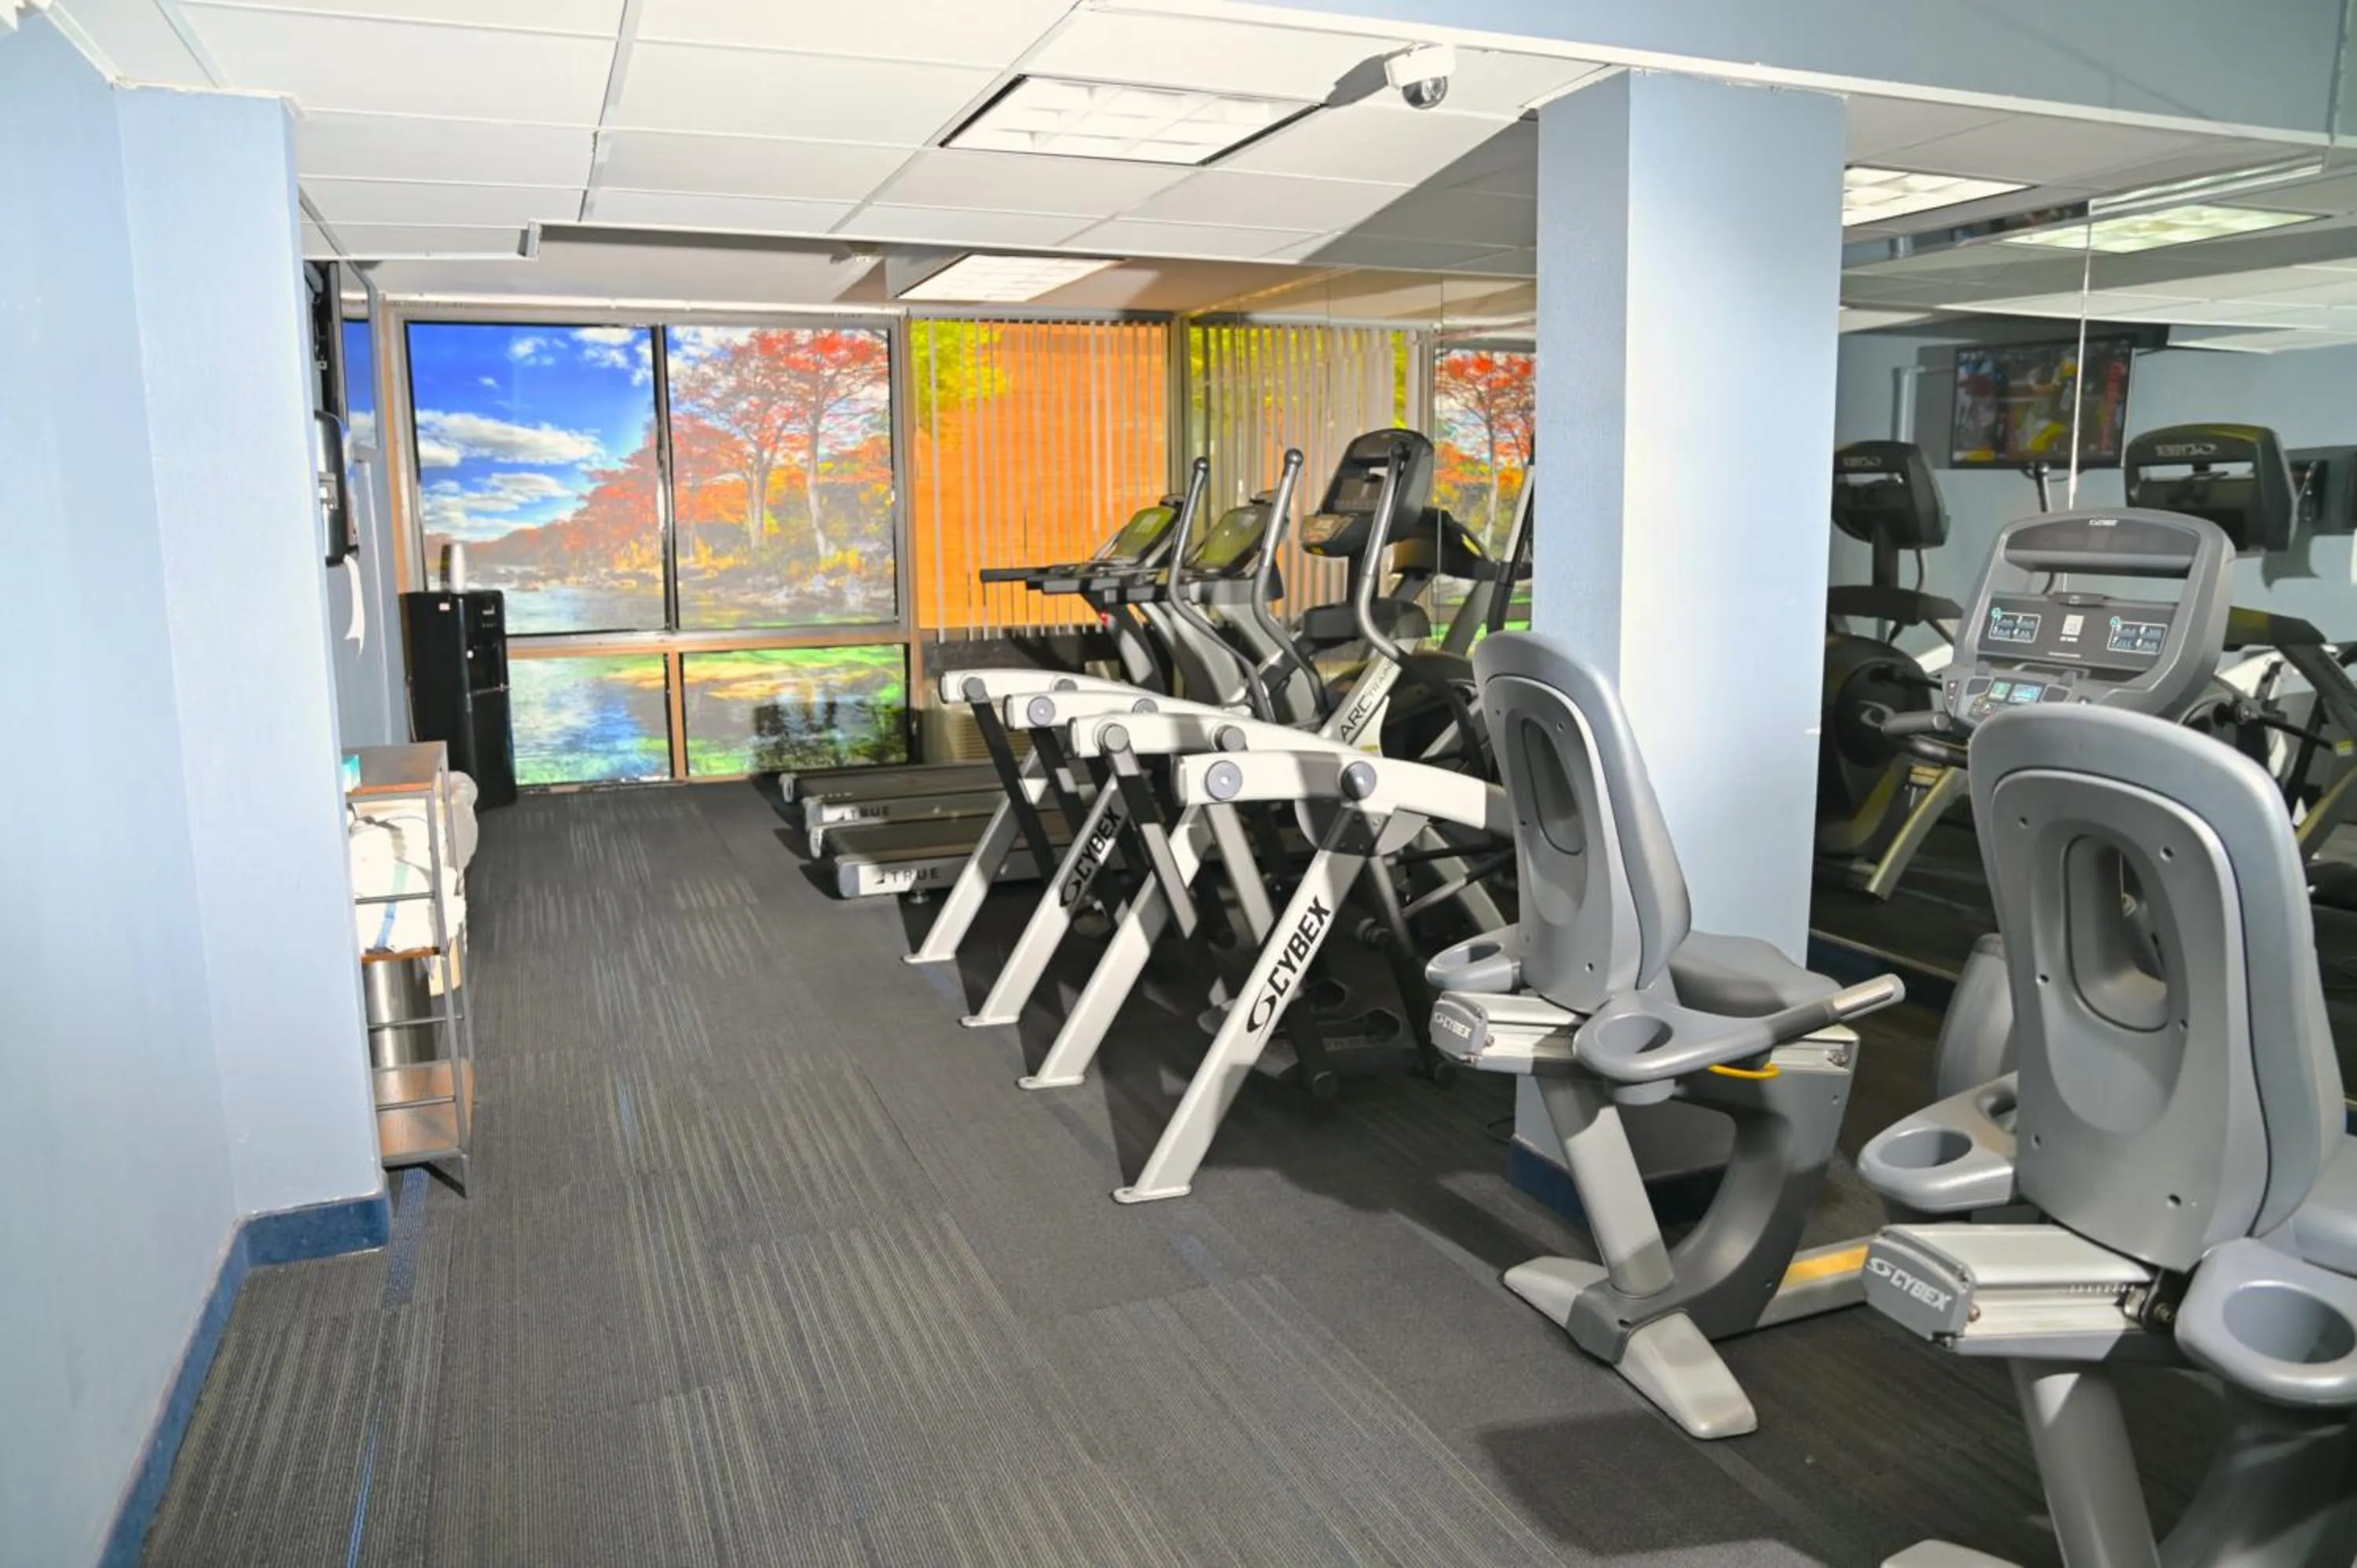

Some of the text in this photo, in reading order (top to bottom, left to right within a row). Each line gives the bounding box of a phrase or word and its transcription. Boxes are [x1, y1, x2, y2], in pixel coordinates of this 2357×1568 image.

[1340, 694, 1373, 741] ARC
[1075, 805, 1121, 881] CYBEX
[891, 866, 940, 883] TRUE
[1267, 895, 1331, 998] CYBEX
[1890, 1269, 1952, 1312] CYBEX
